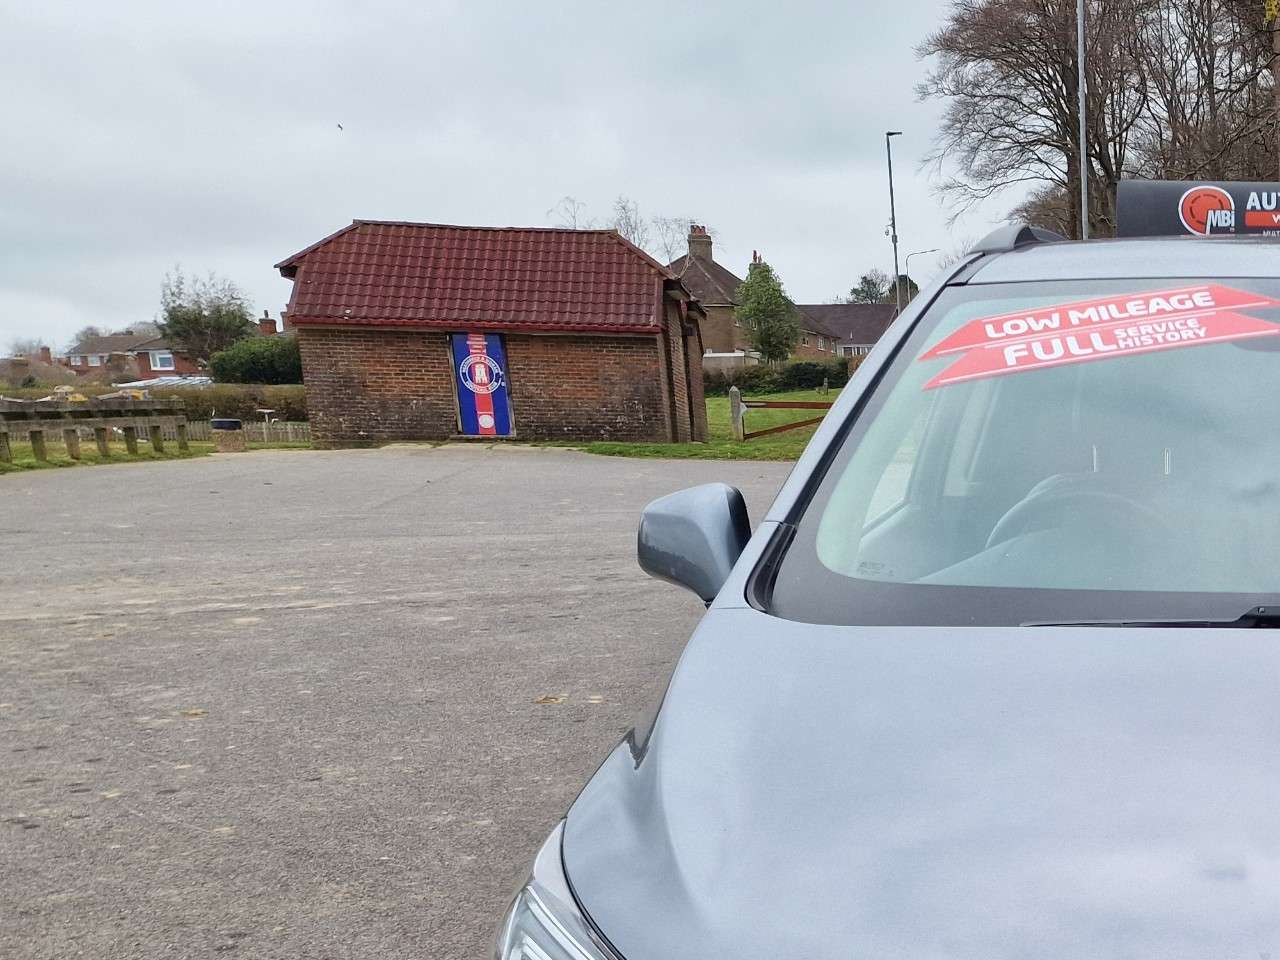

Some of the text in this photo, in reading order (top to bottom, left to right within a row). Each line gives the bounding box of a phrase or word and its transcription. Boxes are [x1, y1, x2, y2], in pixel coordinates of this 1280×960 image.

[985, 290, 1216, 338] LOW MILEAGE
[1118, 326, 1208, 350] HISTORY
[1003, 317, 1200, 367] FULL SERVICE
